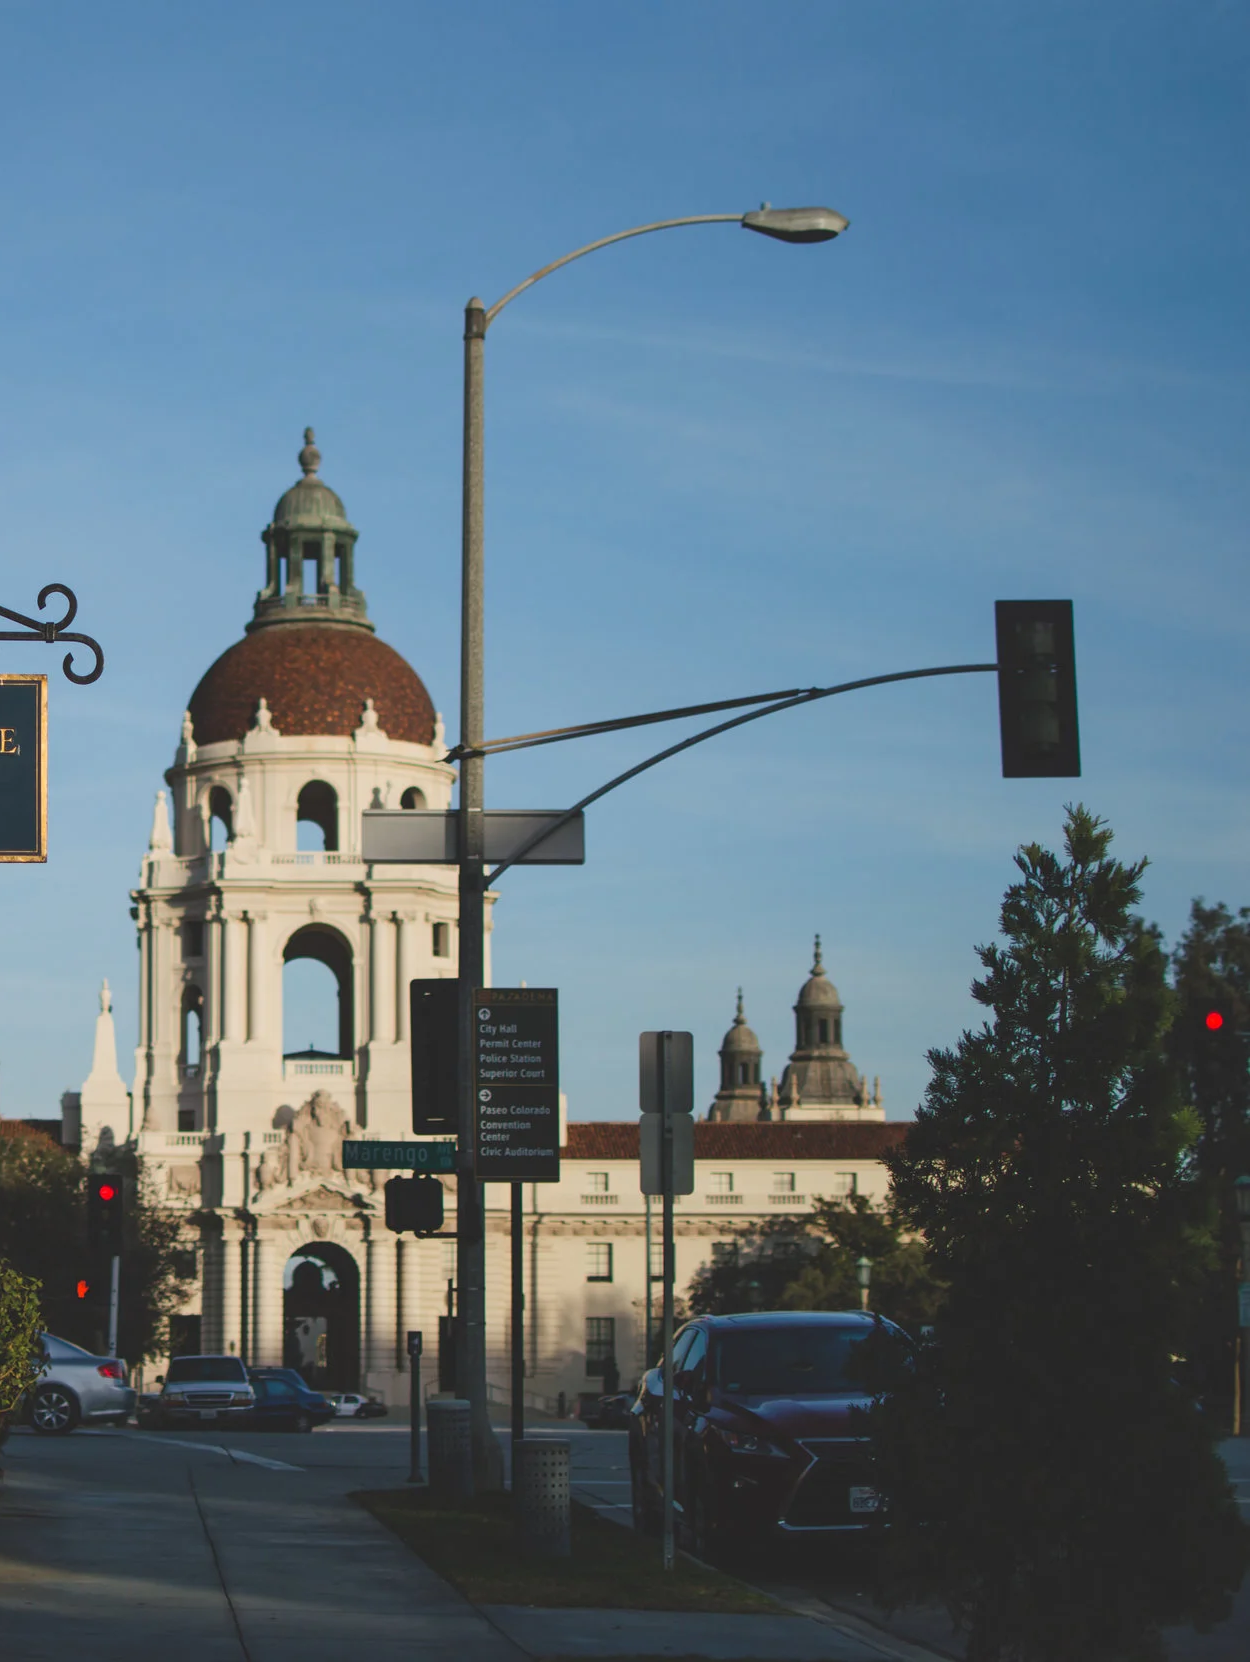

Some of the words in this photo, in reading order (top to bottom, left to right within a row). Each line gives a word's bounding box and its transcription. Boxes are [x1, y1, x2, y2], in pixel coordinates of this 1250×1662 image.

[479, 1024, 496, 1036] City
[500, 1024, 517, 1033] Hall
[479, 1039, 509, 1048] Permit
[512, 1039, 542, 1048] Center
[479, 1054, 507, 1063] Police
[510, 1054, 541, 1063] Station
[479, 1069, 517, 1080] Superior
[520, 1069, 545, 1078] Court
[480, 1106, 507, 1115] Paseo
[510, 1106, 550, 1115] Colorado
[480, 1121, 531, 1129] Convention
[480, 1132, 510, 1141] Center
[345, 1143, 428, 1168] Marengo
[480, 1147, 501, 1156] Civic
[504, 1147, 553, 1156] Auditorium
